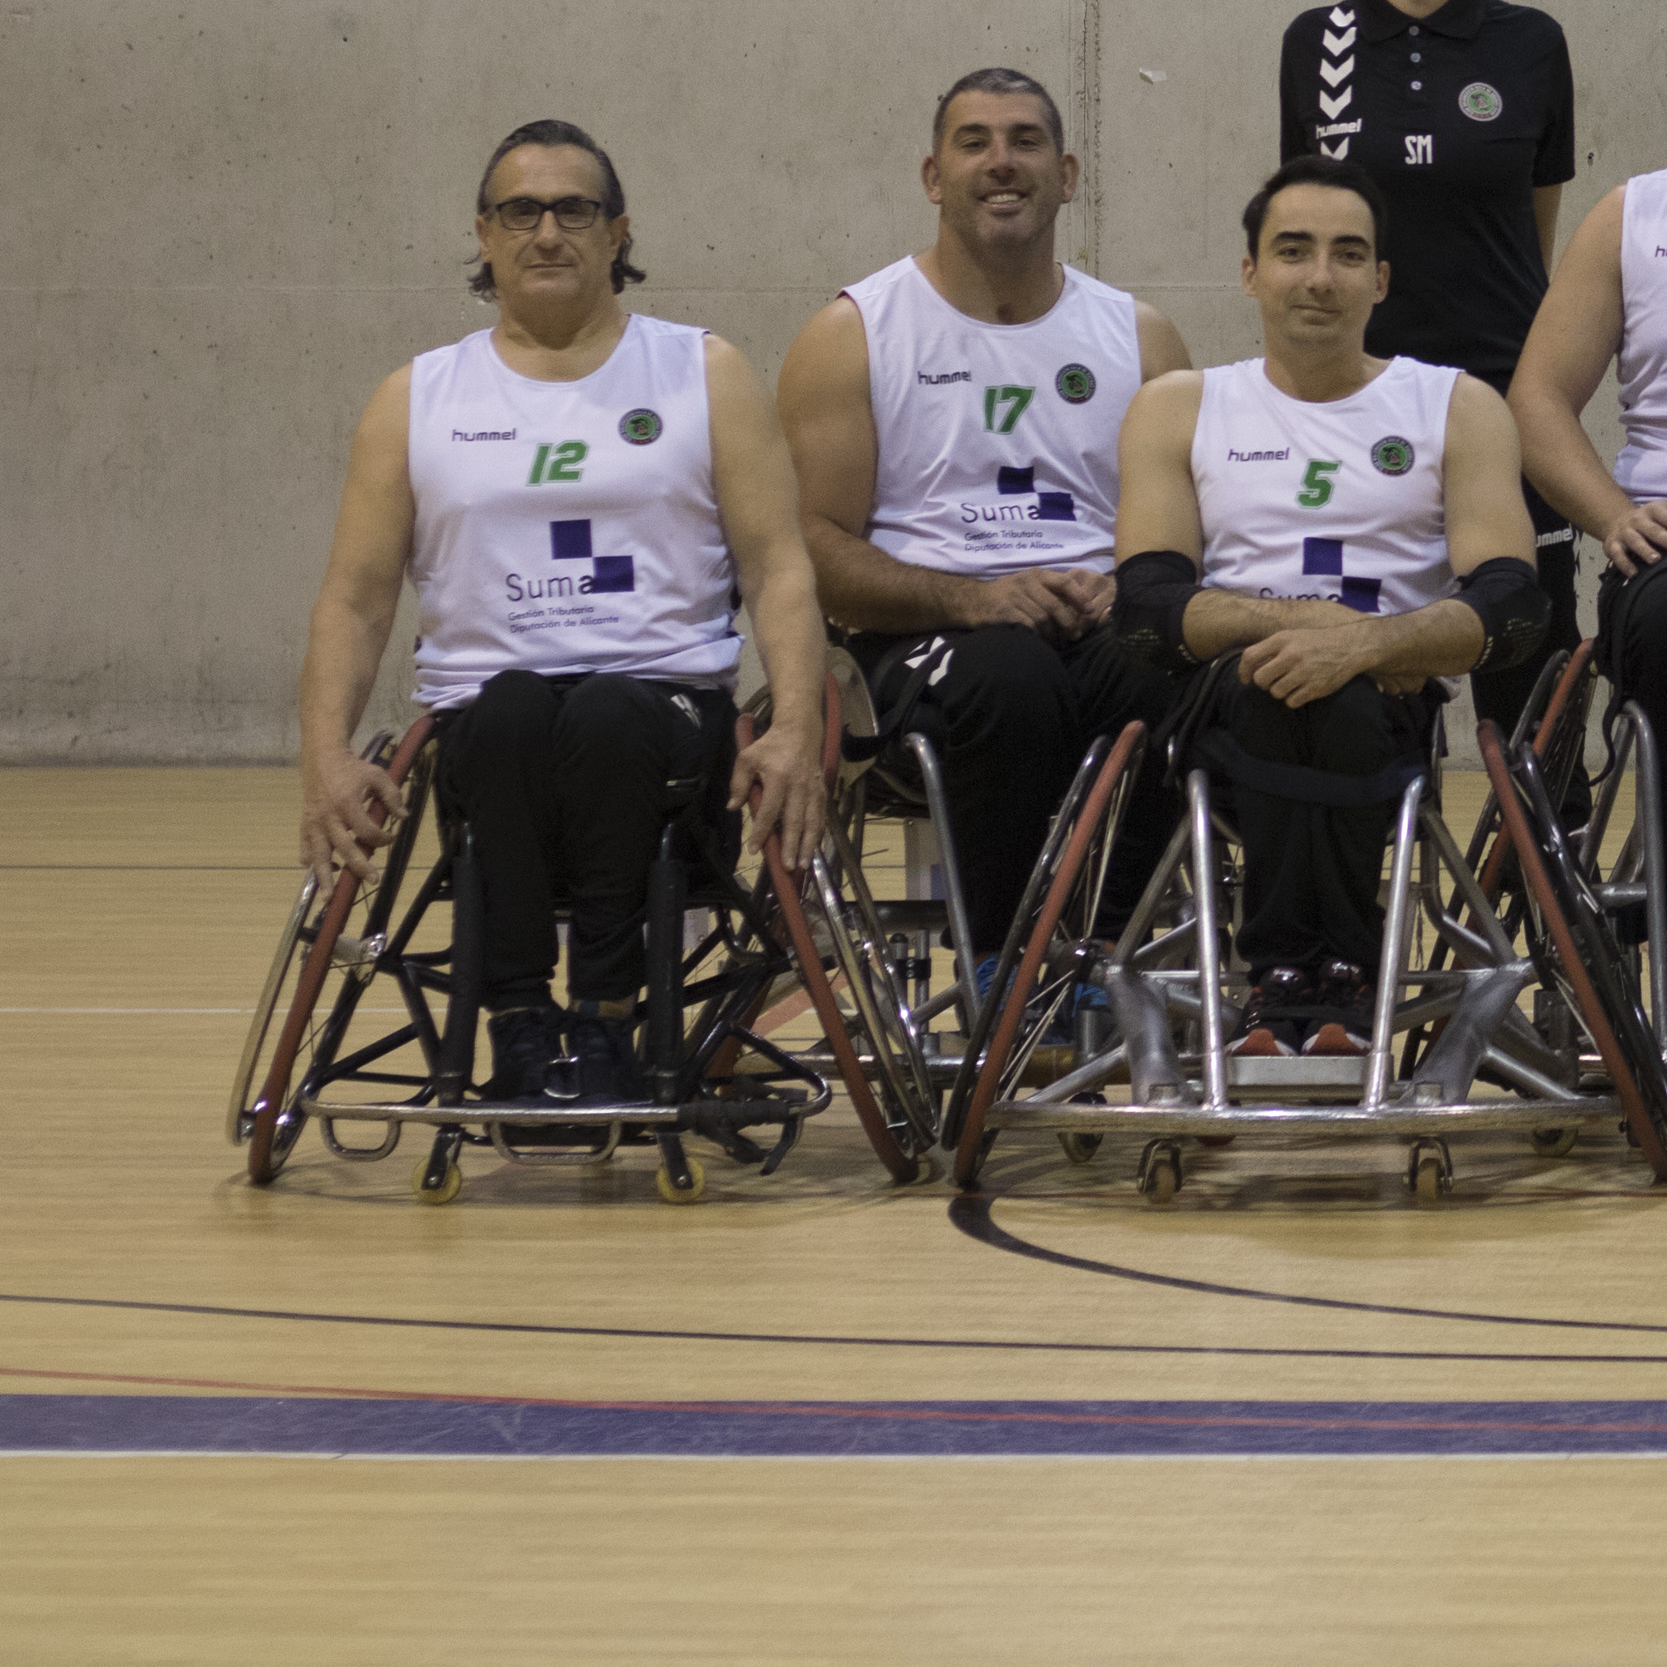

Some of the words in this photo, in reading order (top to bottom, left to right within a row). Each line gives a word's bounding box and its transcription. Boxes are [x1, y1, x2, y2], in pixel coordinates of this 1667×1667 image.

[1316, 118, 1362, 139] hummel
[1404, 135, 1433, 165] SM
[984, 384, 1036, 435] 17
[451, 428, 517, 442] hummel
[525, 439, 589, 487] 12
[1227, 447, 1290, 462] hummel
[1294, 459, 1342, 510] 5
[961, 502, 1041, 523] Suma
[1000, 530, 1043, 539] Tributaria
[964, 541, 1013, 552] Diputación
[1015, 541, 1027, 550] de
[506, 573, 594, 602] Suma
[508, 609, 544, 621] Gestión
[548, 606, 594, 616] Tributaria
[510, 620, 560, 633] Diputación
[564, 619, 576, 627] de
[580, 615, 619, 625] Alicante
